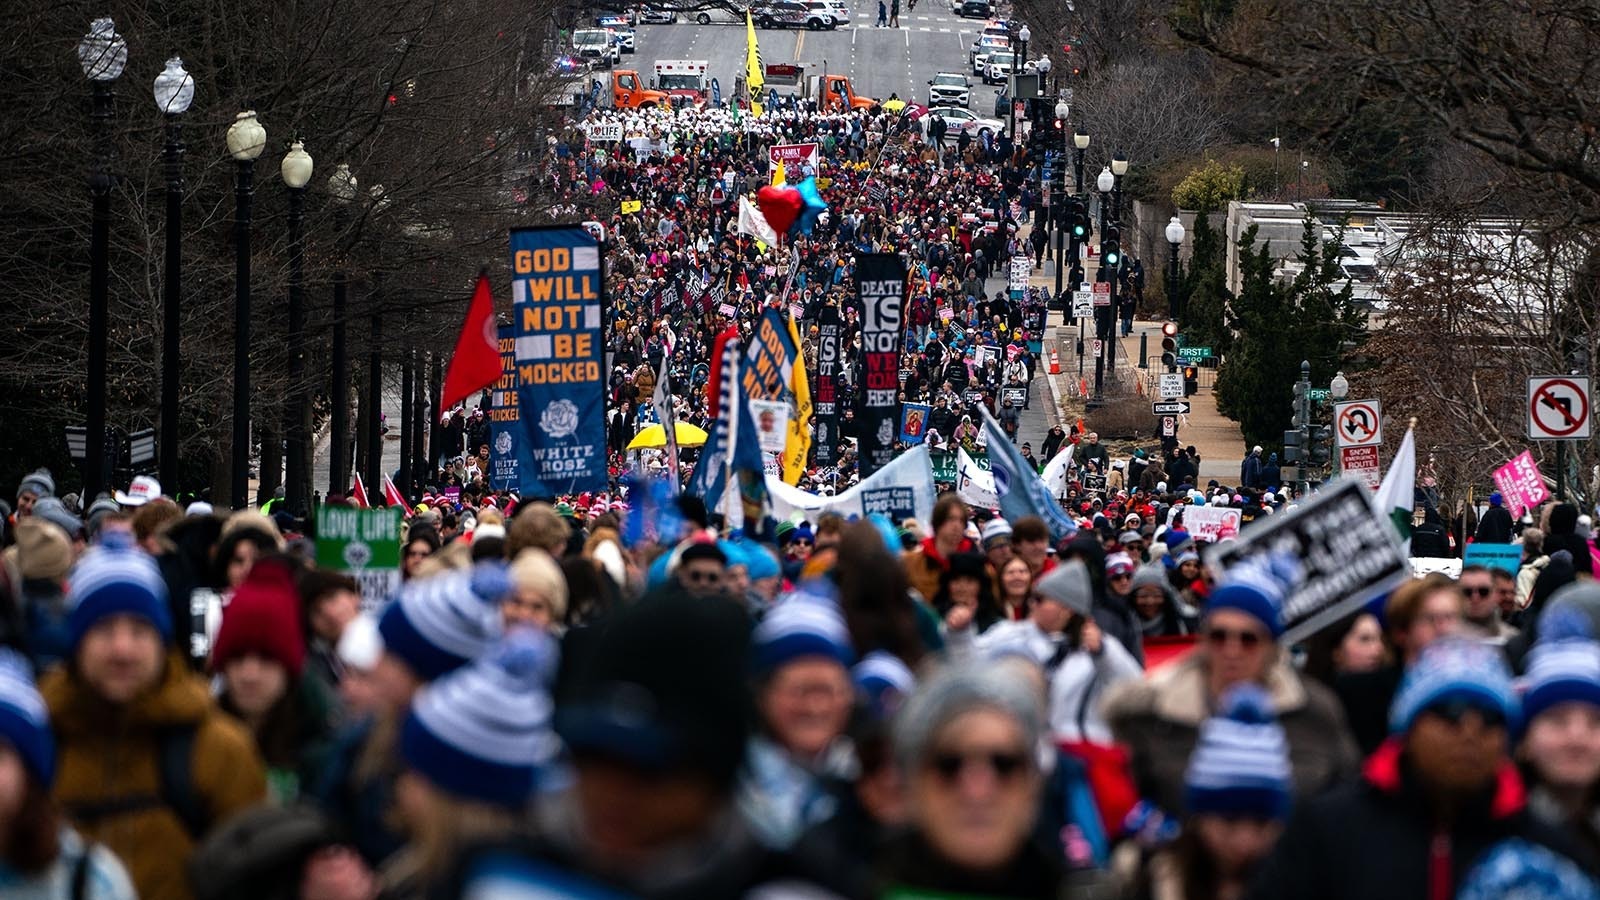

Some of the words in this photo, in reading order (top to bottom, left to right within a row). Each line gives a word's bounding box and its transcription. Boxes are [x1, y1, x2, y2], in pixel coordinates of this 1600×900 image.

[601, 126, 619, 136] LIFE
[514, 247, 570, 274] GOD
[528, 275, 598, 302] WILL
[861, 280, 903, 296] DEATH
[523, 305, 582, 332] NOT
[862, 296, 901, 332] IS
[554, 333, 592, 358] BE
[760, 317, 785, 367] GOD
[1179, 348, 1203, 357] FIRST
[519, 361, 600, 385] MOCKED
[503, 391, 519, 405] BE
[533, 445, 594, 461] WHITE
[541, 458, 586, 473] ROSE
[1348, 461, 1376, 470] ROUTE
[1520, 455, 1545, 501] VIDA
[892, 489, 912, 498] Care
[865, 499, 912, 511] PRO-LIFE
